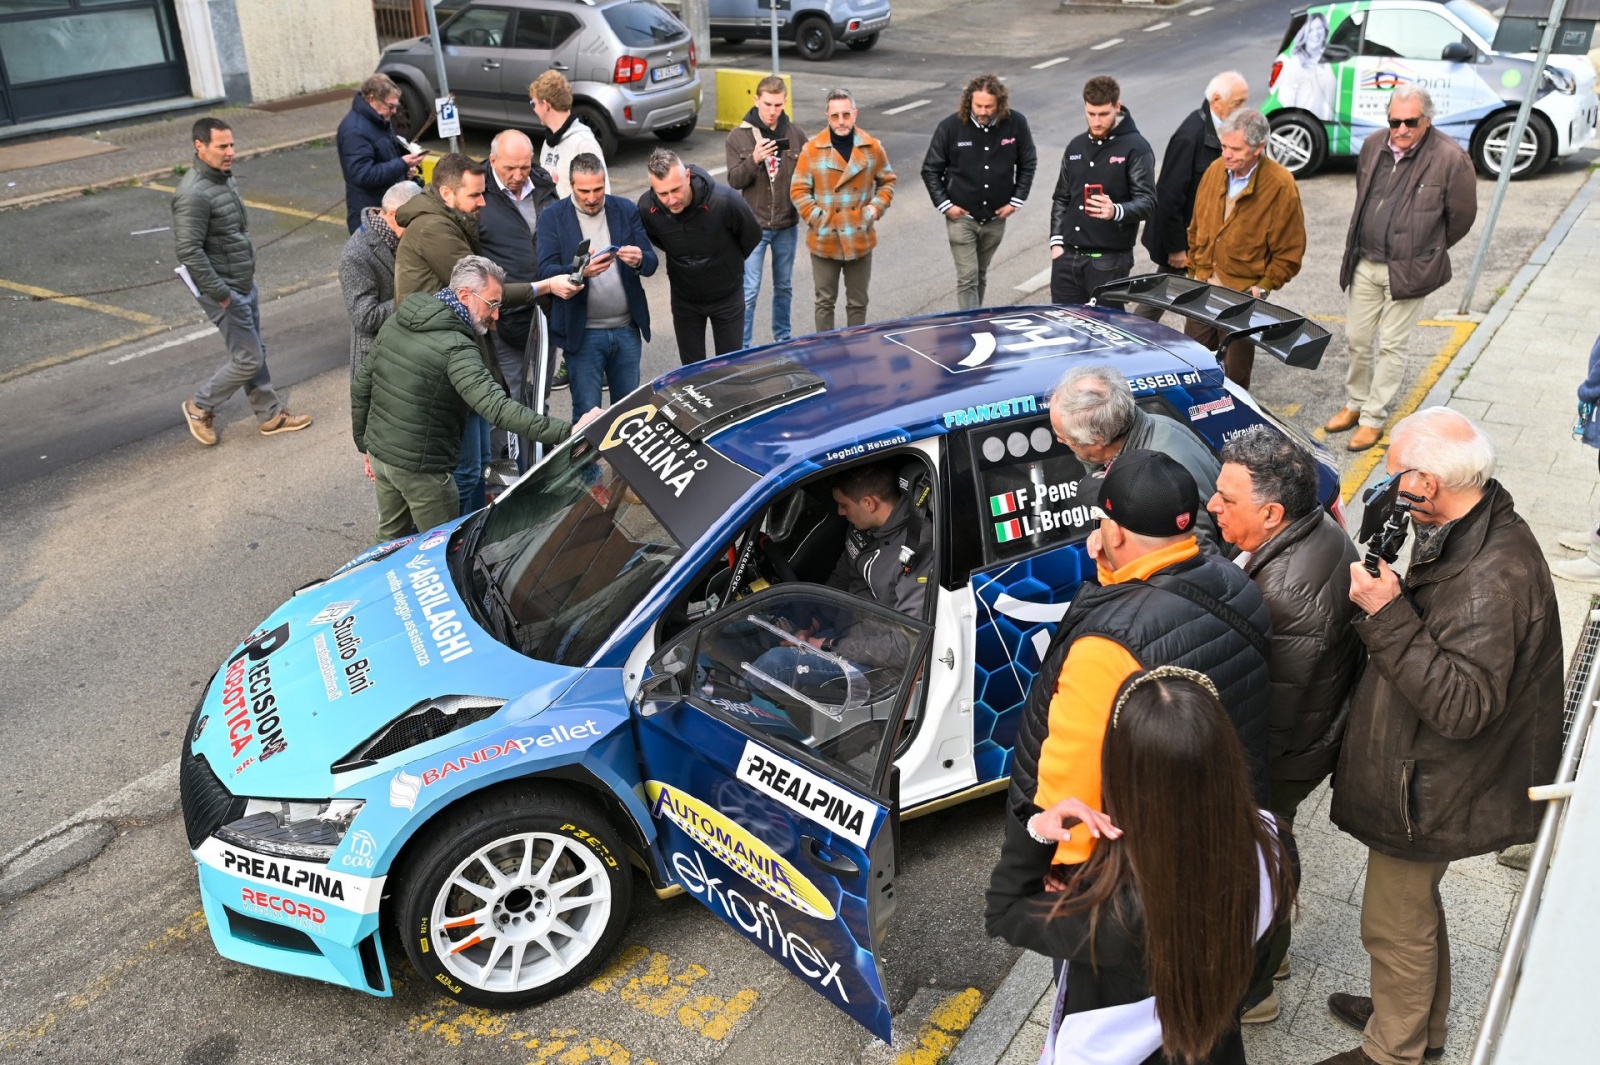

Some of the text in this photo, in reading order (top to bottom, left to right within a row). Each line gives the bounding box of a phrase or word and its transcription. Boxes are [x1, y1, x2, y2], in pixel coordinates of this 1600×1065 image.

[1127, 370, 1202, 392] ESSEBI srl
[943, 395, 1037, 428] FRANZETTI
[618, 418, 695, 498] CELLINA
[655, 422, 708, 470] GRUPPO
[866, 435, 907, 451] Helmets
[1015, 480, 1079, 510] F.Pens
[1022, 504, 1094, 536] L.Brog
[408, 566, 473, 663] AGRILAGHI
[333, 615, 375, 695] Studio Bini
[404, 619, 430, 667] assistenza
[228, 622, 290, 753] PRECISION
[222, 659, 256, 774] ROBOTICA SRL
[746, 755, 865, 836] PREALPINA
[654, 787, 796, 896] AUTOMANIA
[224, 850, 345, 901] PREALPINA
[242, 887, 327, 925] RECORD
[672, 850, 849, 1003] ekaflex
